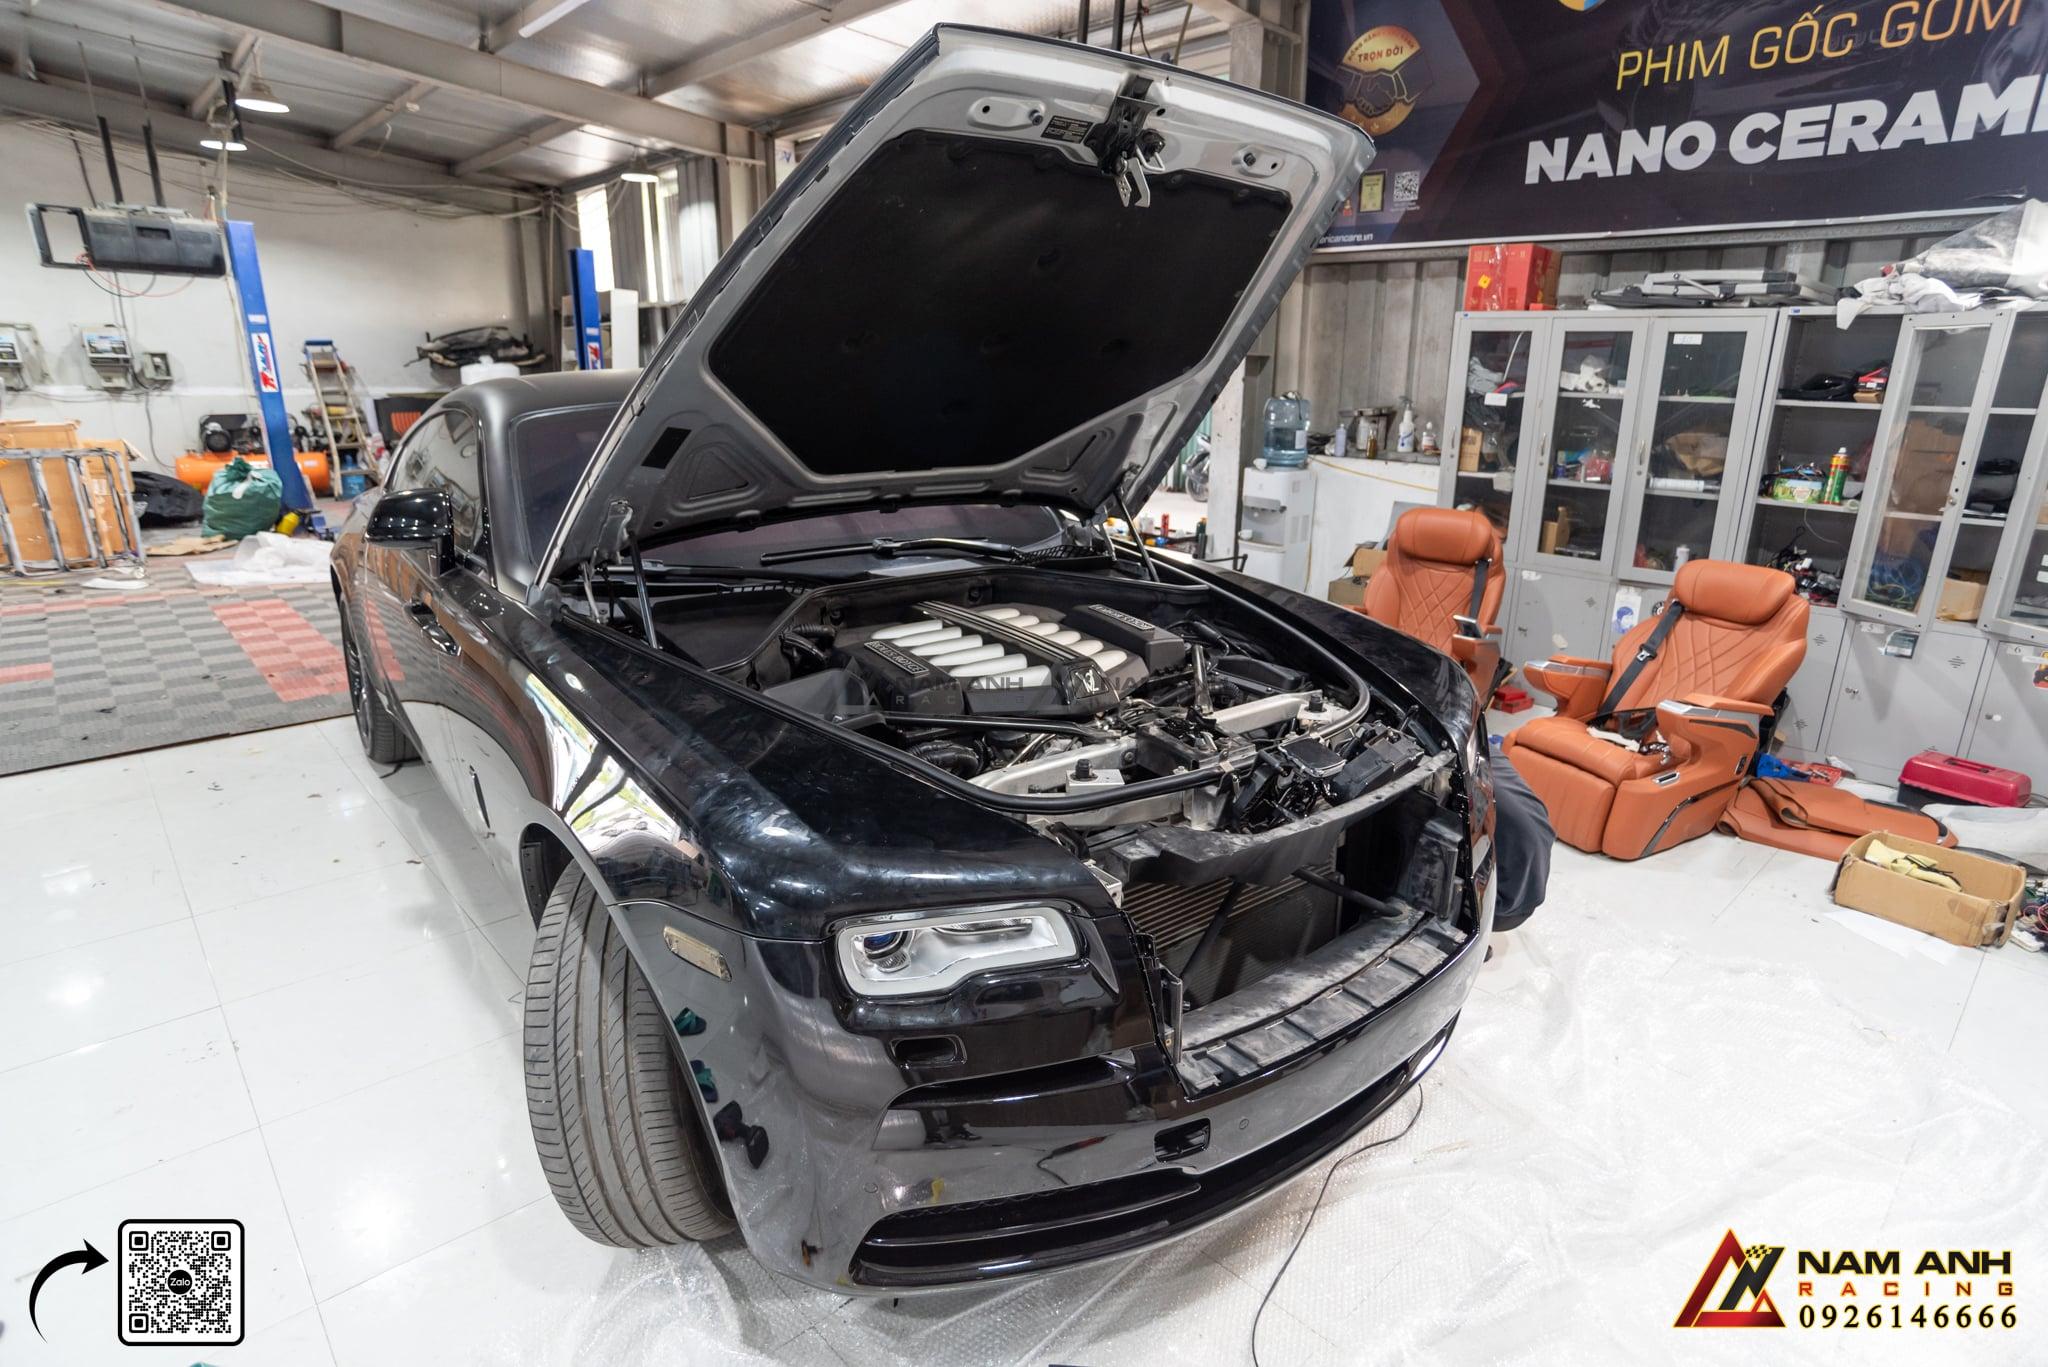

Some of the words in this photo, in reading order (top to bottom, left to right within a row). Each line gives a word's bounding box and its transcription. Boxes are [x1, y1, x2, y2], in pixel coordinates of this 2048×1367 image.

[1617, 34, 1730, 91] PHIM
[1750, 4, 1858, 69] GỐC
[1525, 120, 1716, 185] NANO
